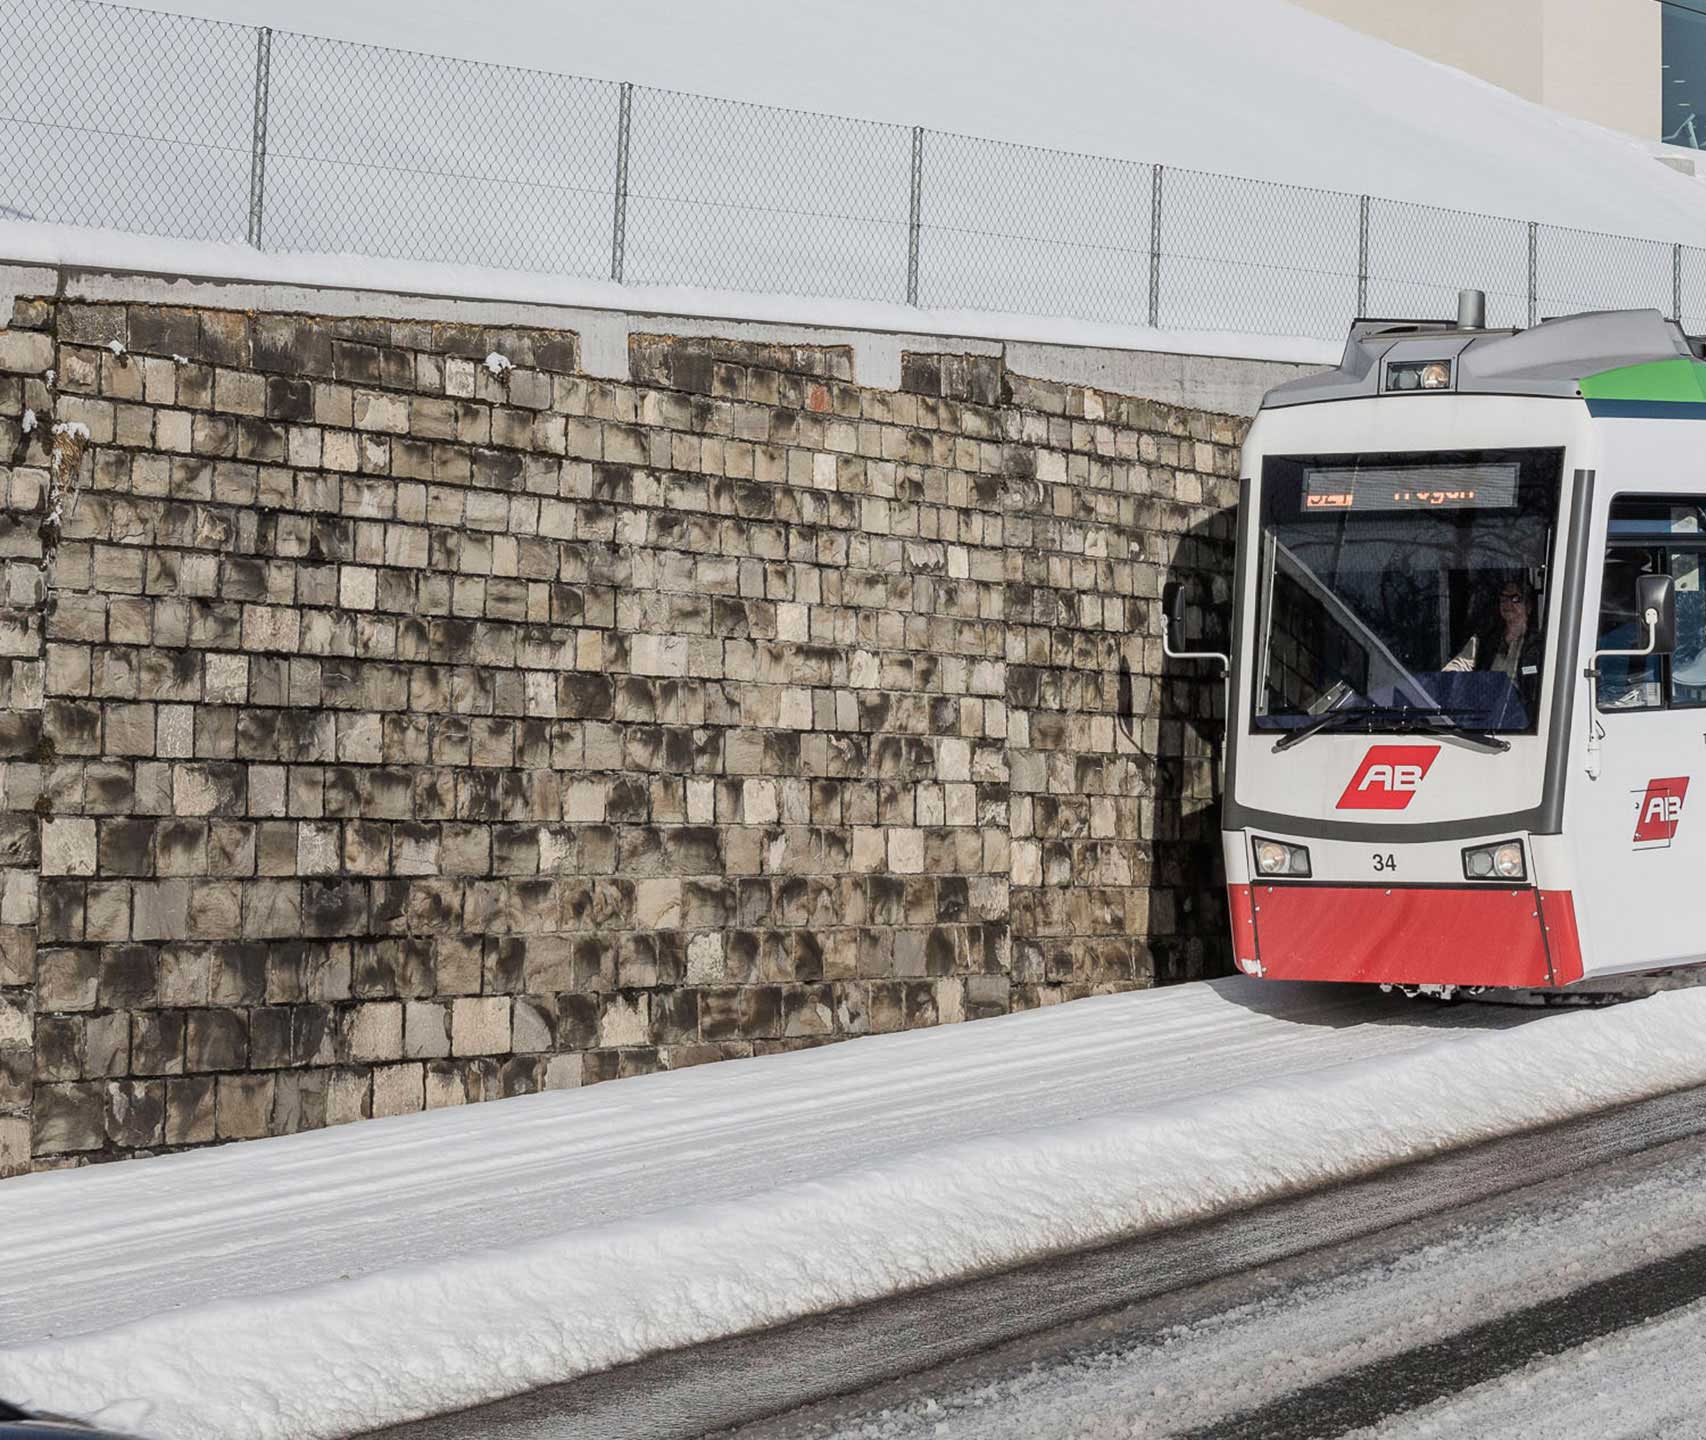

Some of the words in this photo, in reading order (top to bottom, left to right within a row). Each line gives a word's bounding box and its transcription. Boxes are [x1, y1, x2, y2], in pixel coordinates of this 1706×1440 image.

[1357, 763, 1423, 791] AB
[1644, 796, 1682, 823] AB
[1371, 853, 1397, 872] 34
